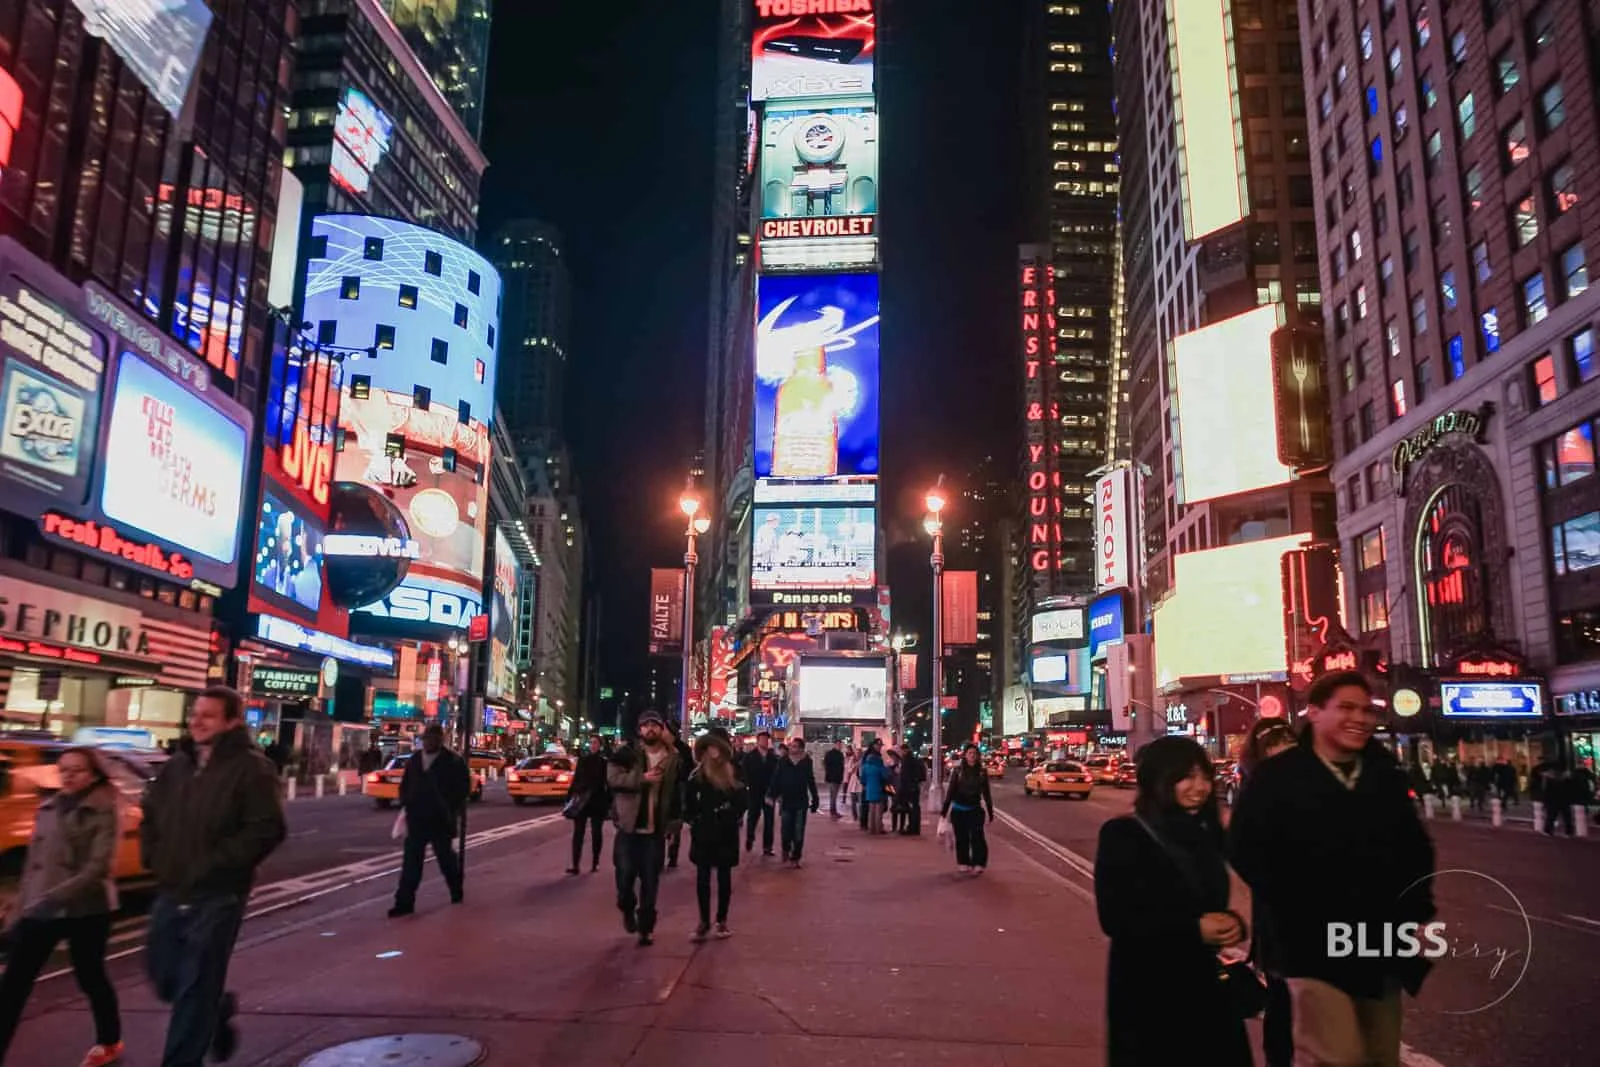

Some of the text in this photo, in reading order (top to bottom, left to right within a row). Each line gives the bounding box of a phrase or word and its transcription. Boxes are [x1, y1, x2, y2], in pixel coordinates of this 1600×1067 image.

[755, 0, 872, 17] TOSHIBA
[764, 217, 873, 237] CHEVROLET
[1022, 266, 1049, 571] ERNST & YOUNG
[282, 417, 331, 505] JVC
[1102, 479, 1114, 584] RICOH
[773, 591, 852, 604] Panasonic
[253, 669, 319, 684] STARBUCKS
[264, 679, 307, 690] COFFEE
[1099, 736, 1127, 745] CHASE
